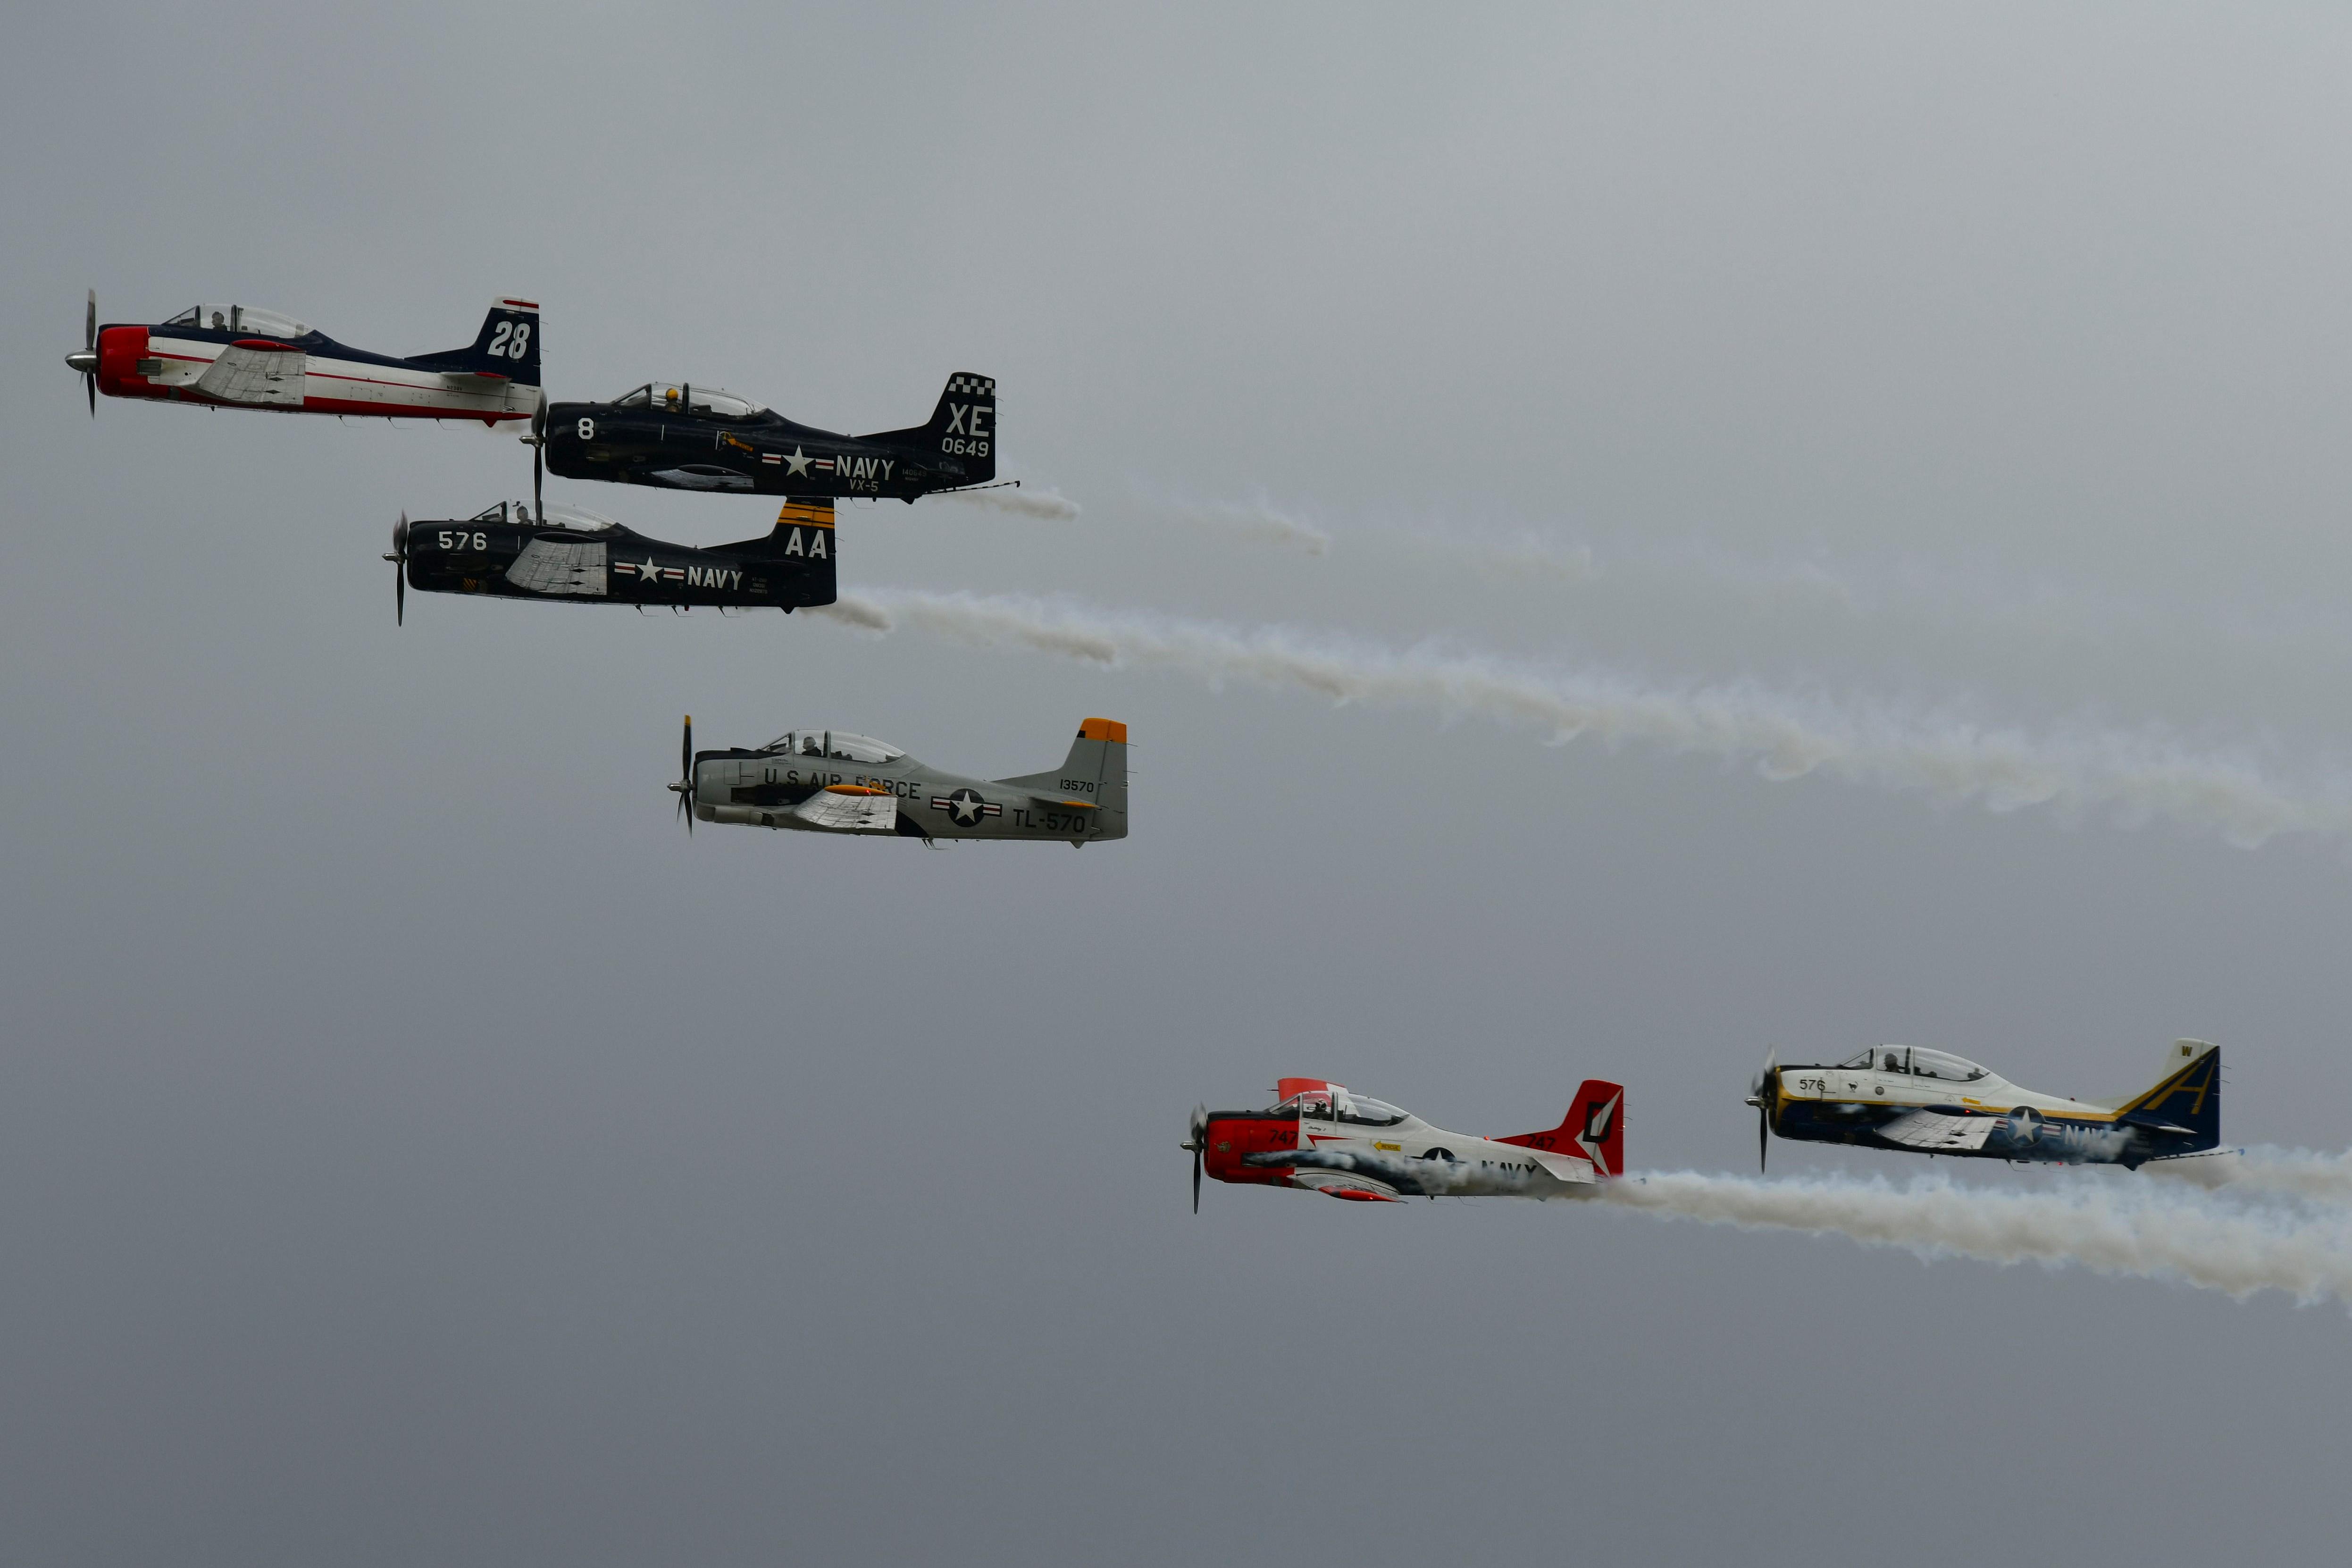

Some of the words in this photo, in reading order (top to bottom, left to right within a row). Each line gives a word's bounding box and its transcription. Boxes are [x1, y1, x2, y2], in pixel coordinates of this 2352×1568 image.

[487, 321, 530, 359] 28
[578, 418, 594, 439] 8
[946, 402, 993, 437] XE
[942, 437, 989, 457] 0649
[836, 455, 895, 480] NAVY
[850, 479, 879, 492] VX-5
[439, 531, 486, 550] 576
[785, 527, 827, 559] AA
[687, 566, 743, 590] NAVY
[810, 772, 842, 788] AIR
[855, 776, 921, 799] FORCE
[1060, 779, 1094, 792] 13570
[1013, 808, 1085, 833] TL-570
[2182, 1046, 2193, 1057] W
[1800, 1079, 1825, 1091] 576
[1269, 1128, 1298, 1145] 747
[1525, 1133, 1556, 1149] 747
[2065, 1124, 2108, 1147] NAV
